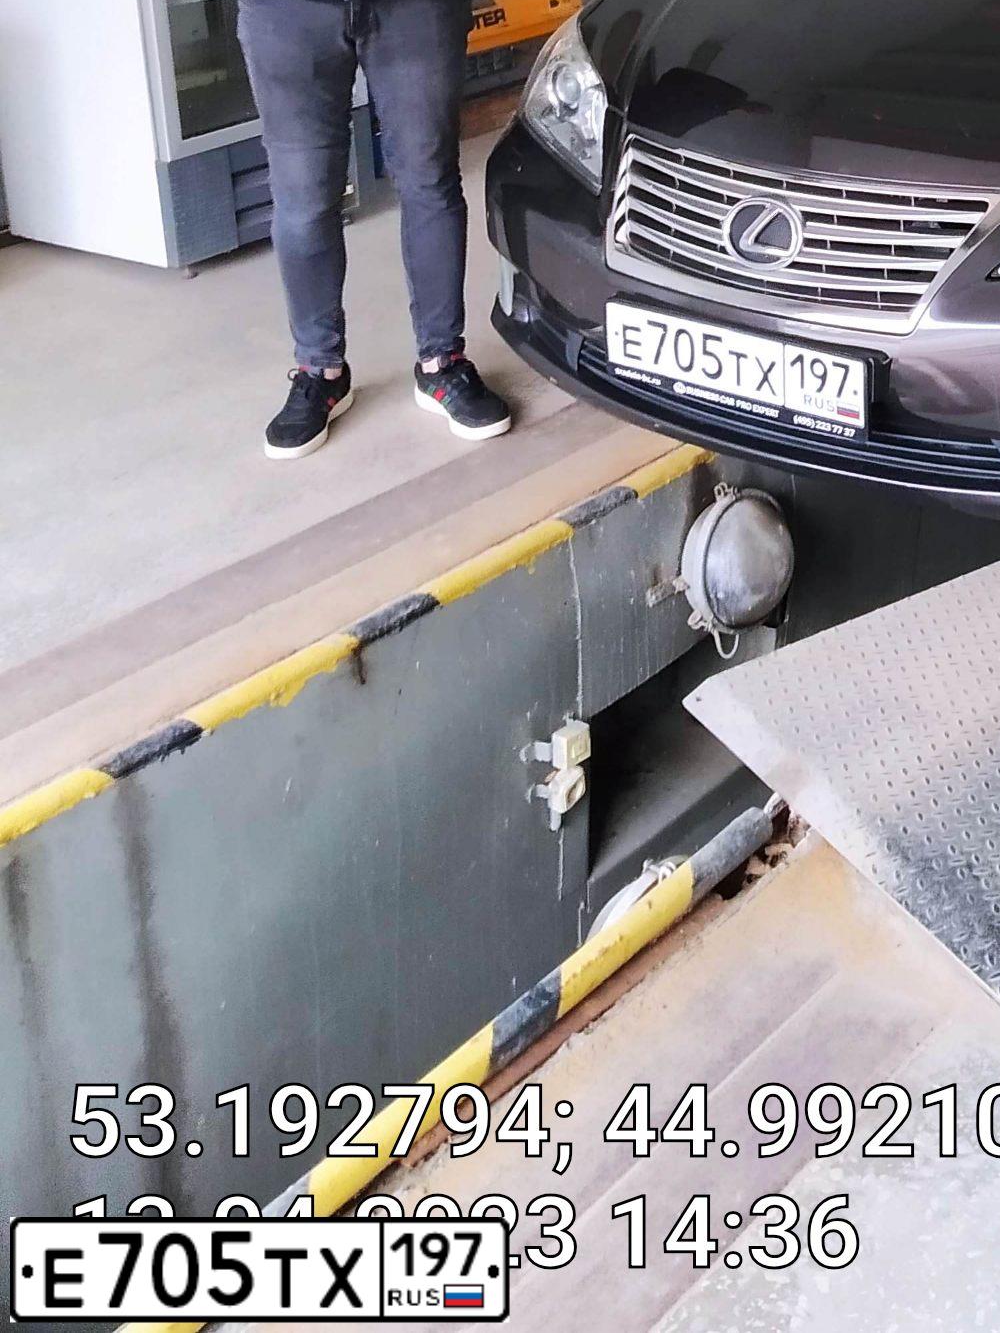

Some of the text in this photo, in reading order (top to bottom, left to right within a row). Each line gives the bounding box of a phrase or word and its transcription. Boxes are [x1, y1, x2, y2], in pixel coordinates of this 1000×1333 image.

[471, 8, 506, 29] TER
[790, 354, 850, 399] 197
[803, 394, 836, 413] RUS
